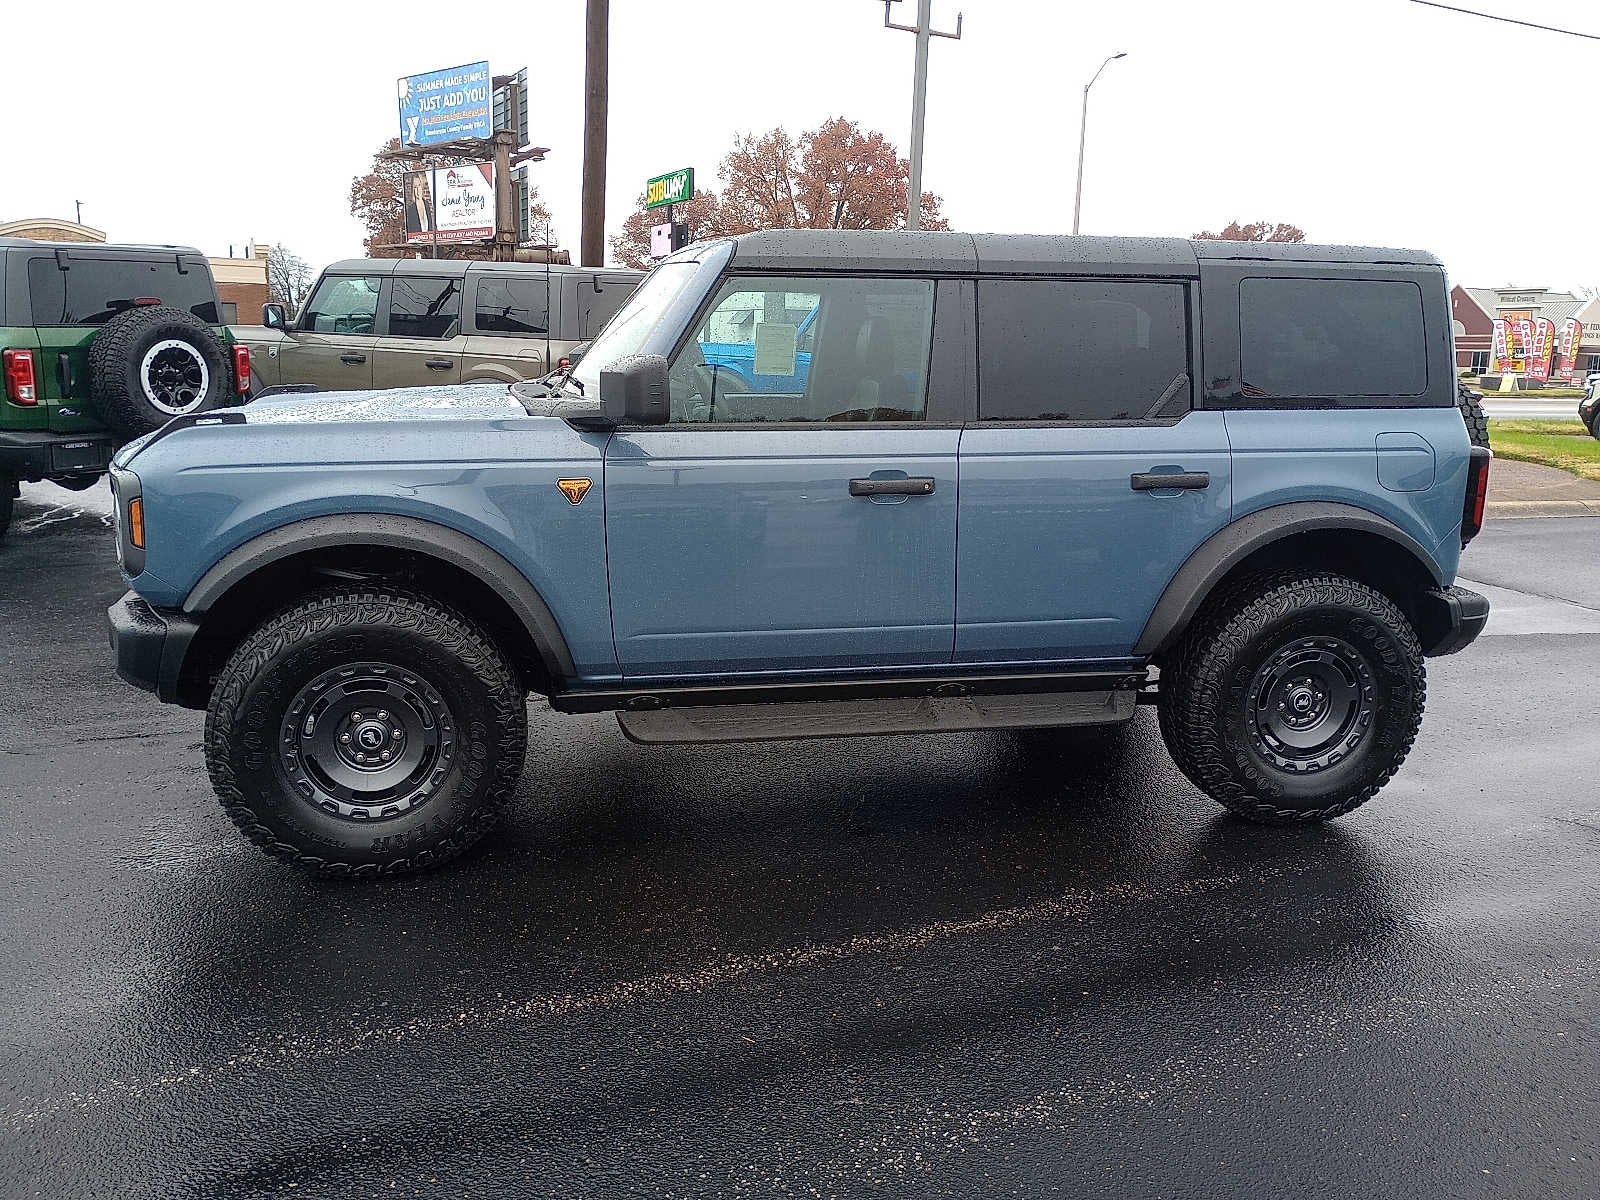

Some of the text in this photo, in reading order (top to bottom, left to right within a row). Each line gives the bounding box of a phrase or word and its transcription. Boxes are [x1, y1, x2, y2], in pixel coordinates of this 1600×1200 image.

[417, 71, 487, 93] SUMMER MADE SIMPLE
[419, 86, 486, 112] JUST ADD YOU
[648, 174, 687, 204] SUBWAY
[1495, 322, 1506, 354] CASH
[1534, 322, 1546, 353] CASH
[1562, 322, 1574, 353] CASH
